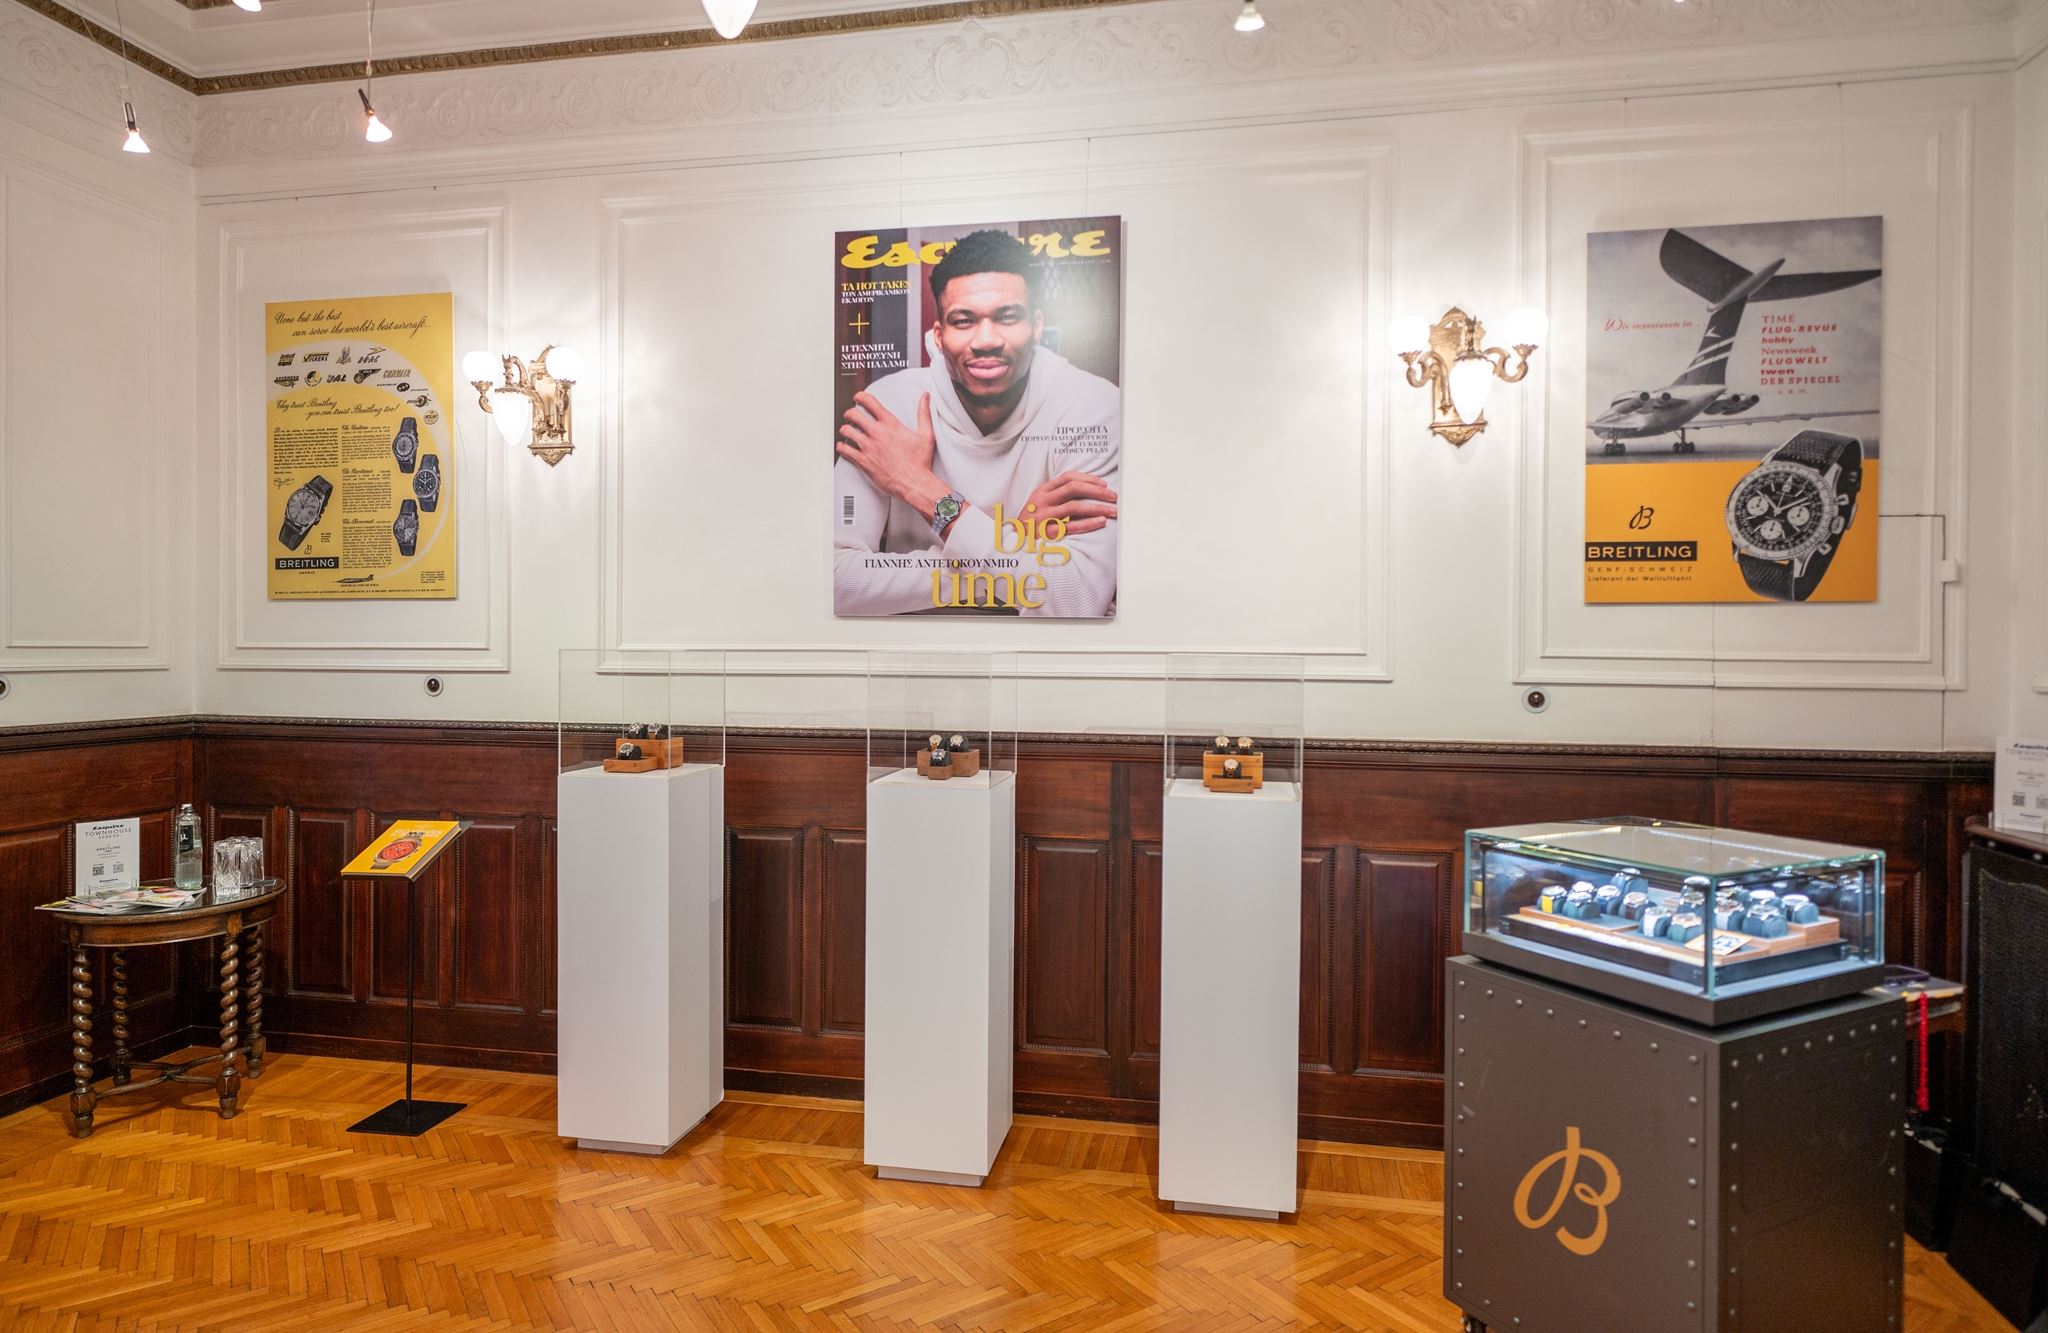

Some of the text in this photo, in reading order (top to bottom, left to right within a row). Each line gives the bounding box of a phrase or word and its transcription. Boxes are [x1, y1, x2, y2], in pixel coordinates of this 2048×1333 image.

[857, 281, 876, 291] HOT
[879, 280, 912, 289] TAKES
[297, 310, 311, 323] but
[312, 309, 325, 322] the
[325, 308, 342, 321] best
[1763, 314, 1796, 324] TIME
[331, 321, 344, 334] the
[377, 318, 395, 331] best
[1762, 324, 1838, 334] FLUG-REVUE
[1761, 336, 1794, 345] hobby
[850, 343, 894, 352] ΤΕΧΝΗΤΗ
[1761, 346, 1817, 355] Newsweek
[841, 352, 901, 361] ΝΟΗΜΟΣΥΝΗ
[1761, 356, 1828, 366] FLUGWELT
[841, 361, 866, 370] ΣΤΗΝ
[1760, 368, 1795, 376] twen
[1760, 375, 1841, 386] DER SPIEGEL
[992, 503, 1071, 567] big
[1588, 546, 1692, 559] BREITLING
[280, 558, 335, 568] BREITLING
[864, 557, 1019, 569] ΓΙΑΝΝΗΣ ΑΝΤΕΤΟΚΟΥΝΜΠΟ
[930, 568, 1047, 609] time
[85, 828, 131, 837] TOWNHOUSE
